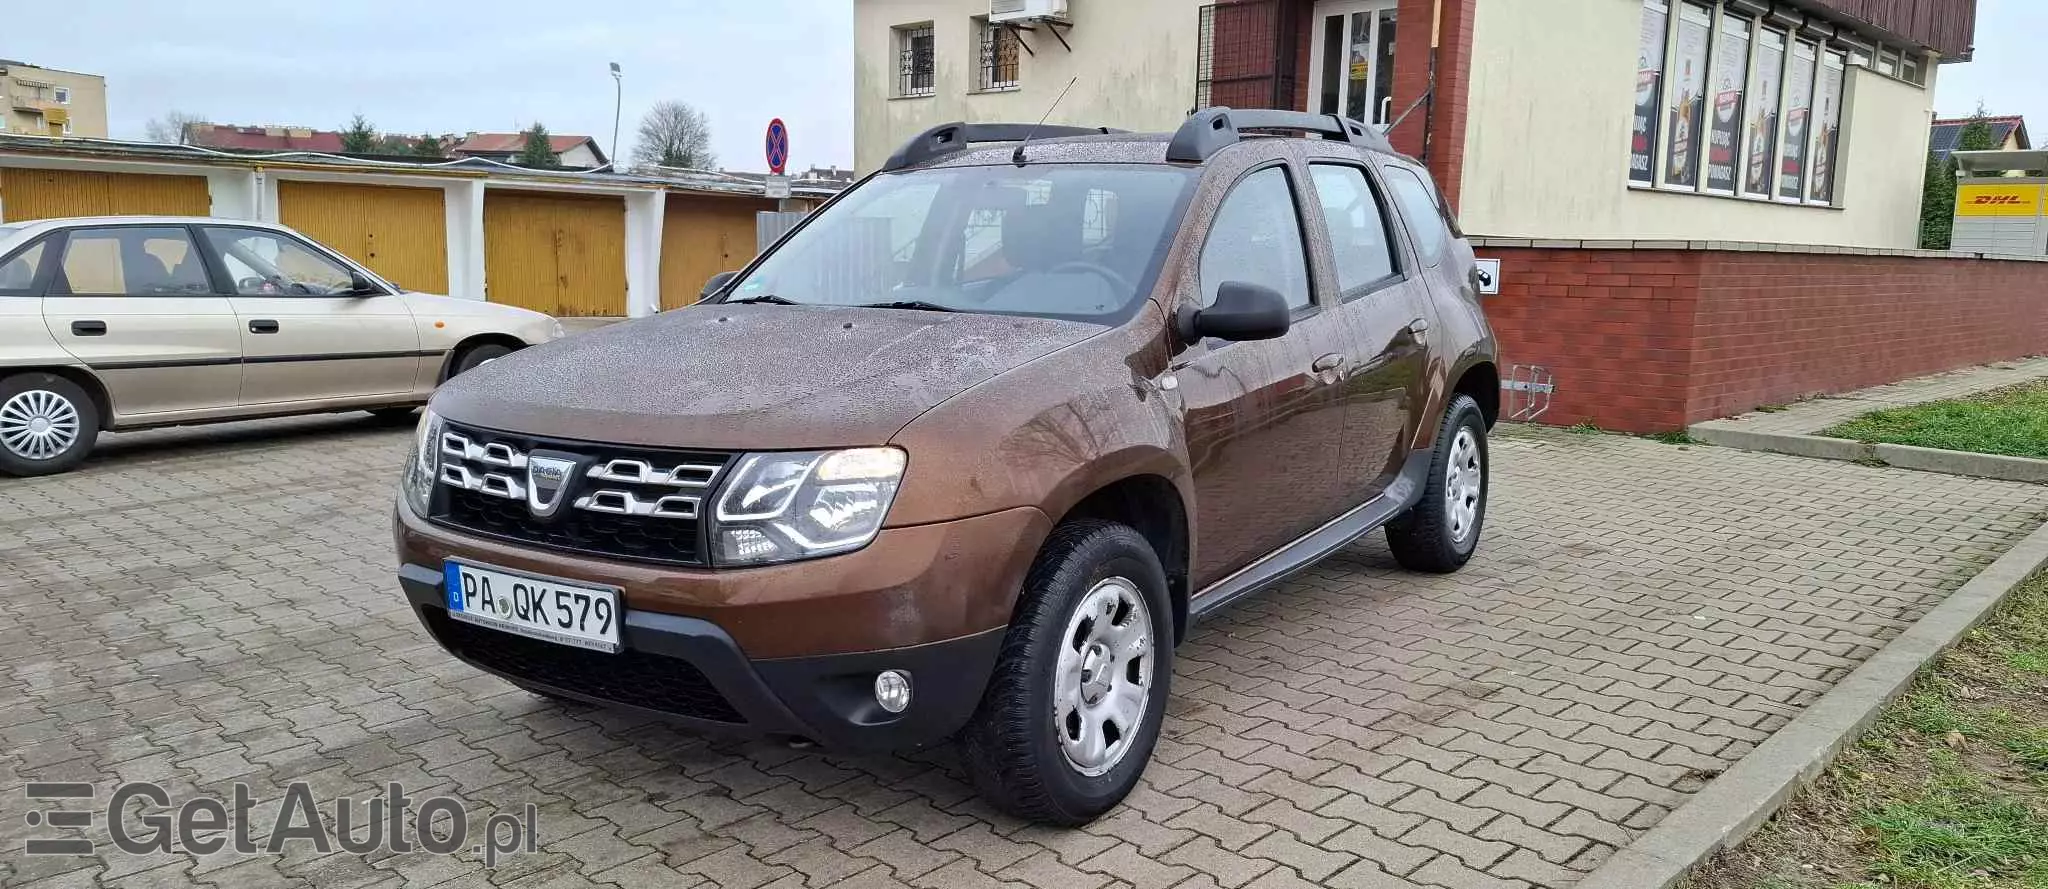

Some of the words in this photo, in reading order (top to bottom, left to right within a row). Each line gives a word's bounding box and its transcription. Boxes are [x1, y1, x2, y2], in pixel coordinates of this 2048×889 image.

[1974, 195, 2021, 205] DHL
[453, 592, 459, 603] D
[462, 572, 497, 614] PA
